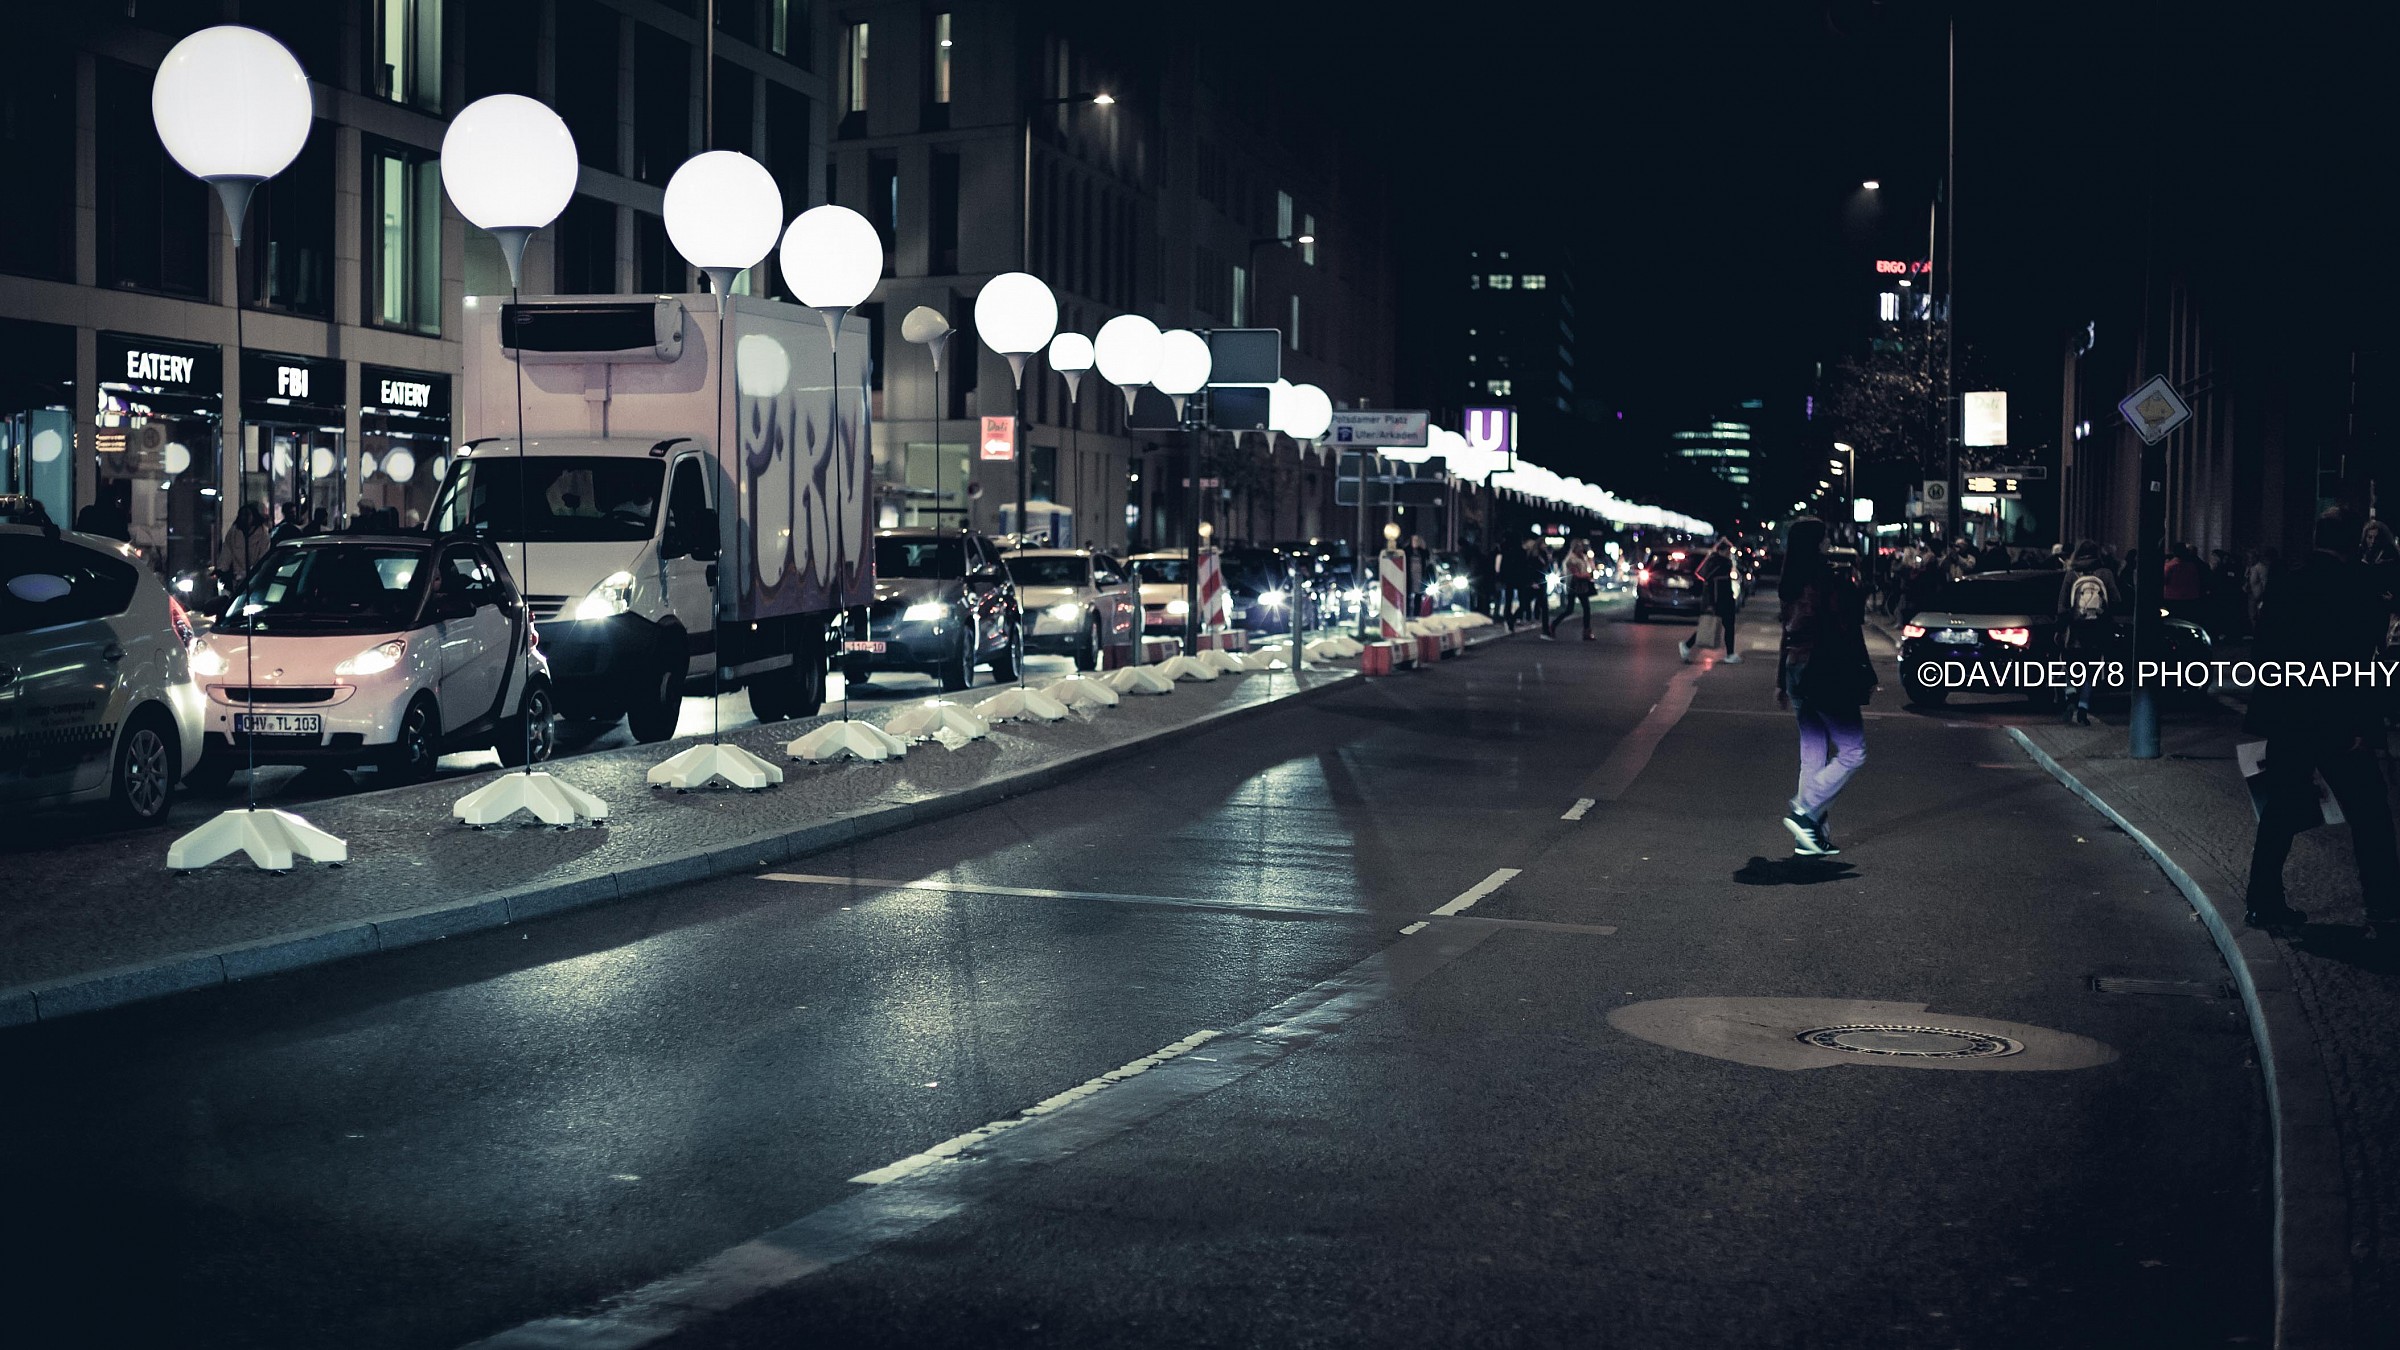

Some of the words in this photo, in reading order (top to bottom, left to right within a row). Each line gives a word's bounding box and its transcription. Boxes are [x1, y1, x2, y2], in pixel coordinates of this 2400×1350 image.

[1876, 259, 1907, 275] ERGO
[126, 350, 194, 384] EATERY
[277, 366, 309, 398] FBI
[380, 379, 431, 408] EATERY
[1384, 414, 1408, 424] Platz
[1469, 409, 1504, 452] U
[243, 717, 267, 730] OHV
[276, 717, 292, 731] TL
[294, 717, 317, 731] 103
